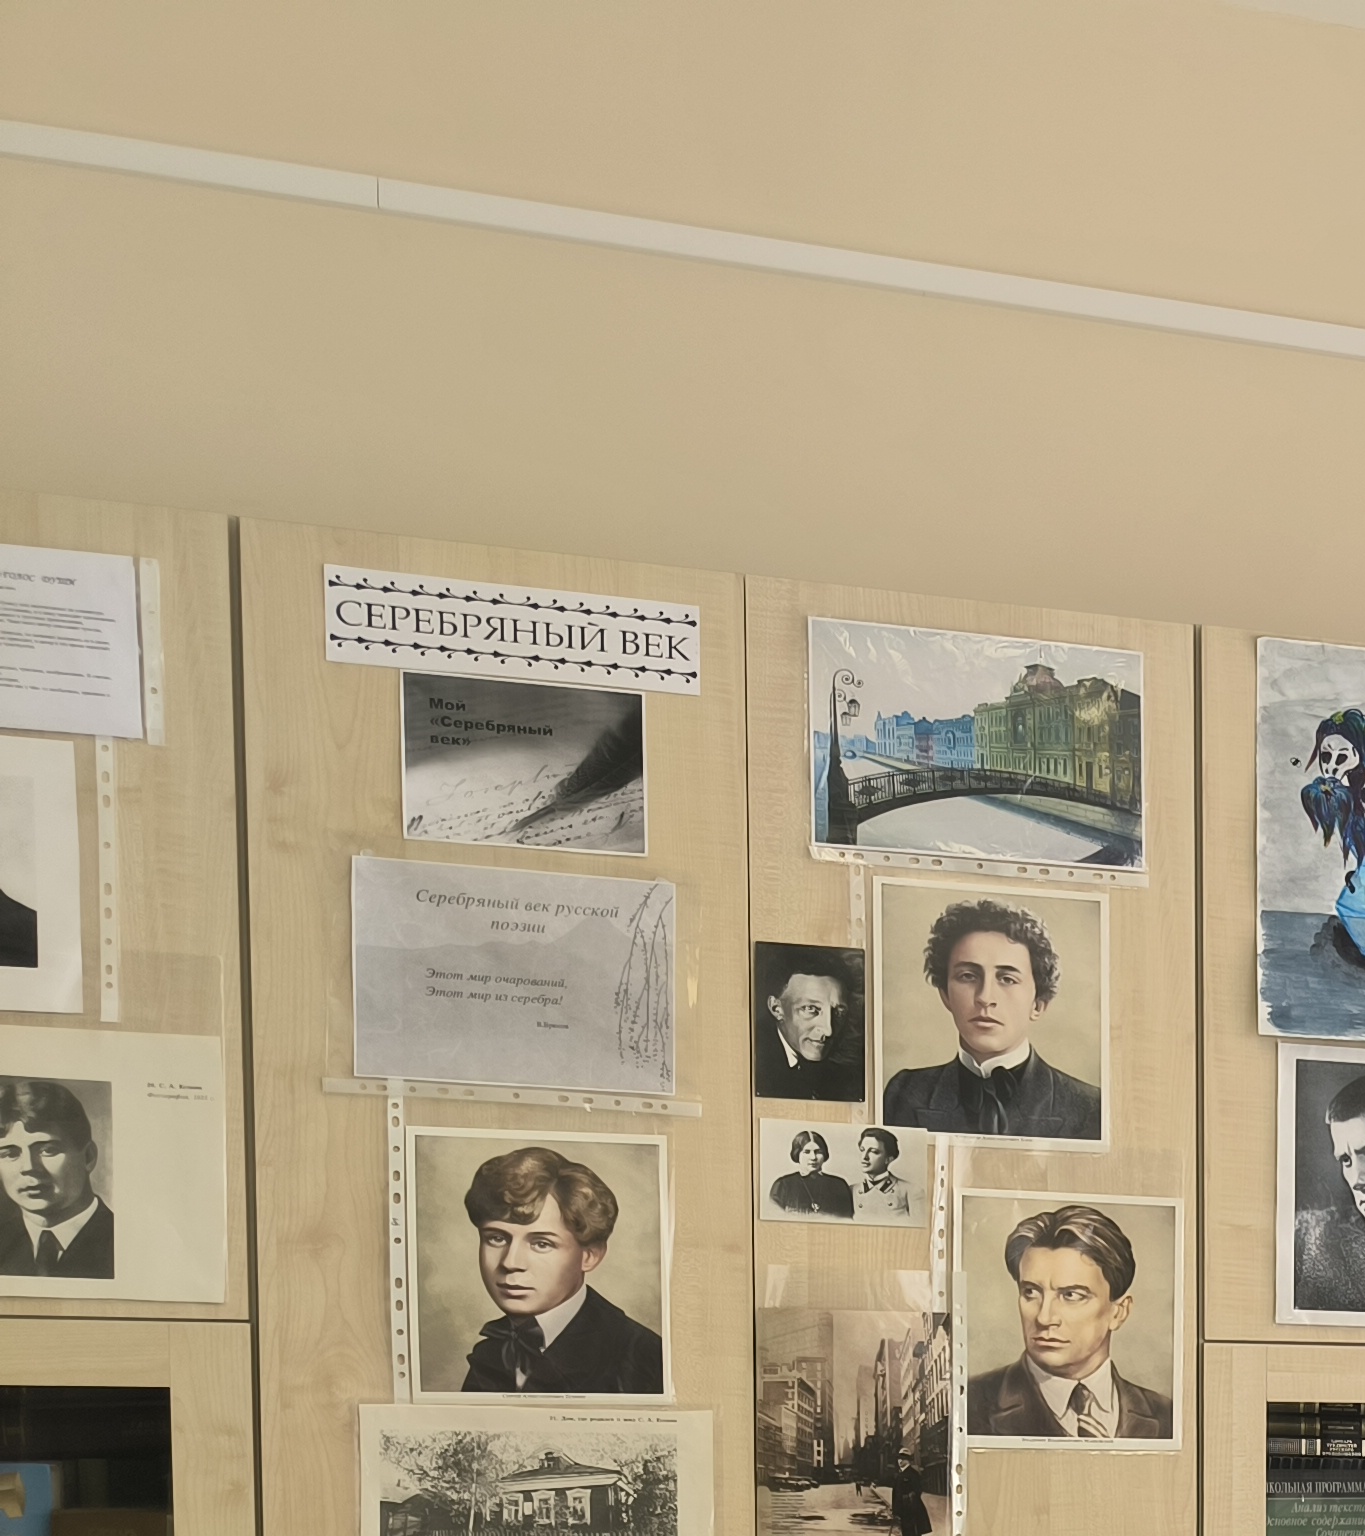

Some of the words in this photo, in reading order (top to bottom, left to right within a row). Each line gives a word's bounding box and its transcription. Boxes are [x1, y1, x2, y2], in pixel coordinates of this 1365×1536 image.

[335, 600, 607, 653] СЕРЕБРЯНЫЙ
[620, 630, 691, 662] ВЕК
[429, 697, 466, 712] Мой
[430, 715, 553, 737] «Серебряный
[430, 734, 471, 747] век»
[416, 889, 520, 911] Серебряный
[524, 900, 552, 913] век
[554, 903, 620, 919] русской
[490, 920, 546, 934] поэзии
[425, 967, 463, 981] Этот
[466, 974, 492, 985] мир
[494, 975, 568, 990] очарований,
[425, 985, 463, 999] Этот
[466, 992, 492, 1003] мир
[494, 993, 509, 1002] из
[511, 994, 564, 1007] серебра!
[1266, 1481, 1313, 1494] КОЛЬНАЯ
[1291, 1502, 1327, 1514] Анализ
